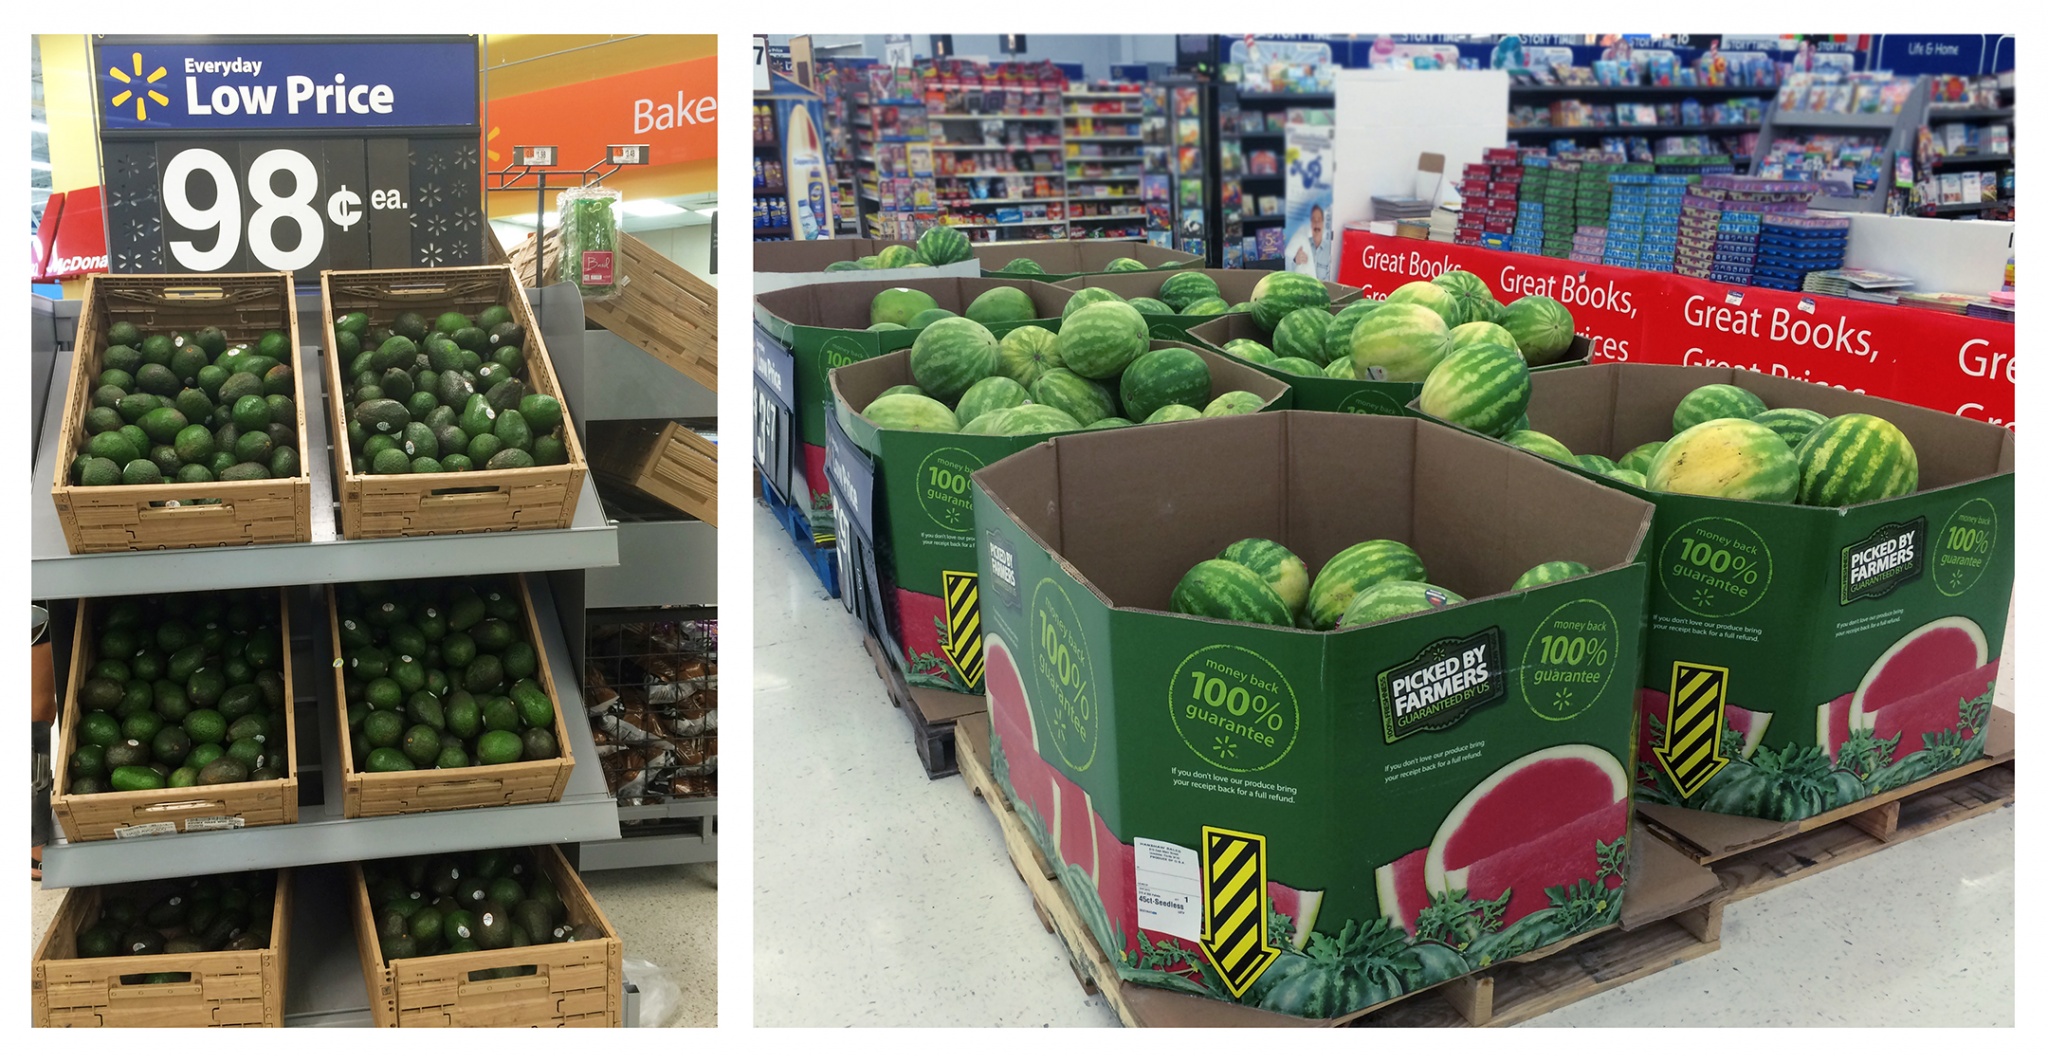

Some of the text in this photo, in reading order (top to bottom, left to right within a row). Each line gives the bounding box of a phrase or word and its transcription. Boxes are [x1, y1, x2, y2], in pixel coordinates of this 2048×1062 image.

[1908, 42, 1959, 55] Life & Home
[184, 57, 262, 77] Everyday
[186, 73, 395, 115] Low Price
[634, 90, 718, 135] Bake
[371, 188, 408, 210] ea.
[1362, 245, 1405, 275] Great
[1500, 265, 1638, 319] Great Books,
[1683, 294, 1762, 339] Great
[1770, 306, 1879, 364] Books,
[937, 458, 963, 471] money
[929, 466, 972, 499] 100
[1696, 528, 1758, 555] money back
[1851, 530, 1916, 569] PICKED BY
[1947, 525, 1990, 554] 100%
[1680, 538, 1758, 585] 100%
[1850, 545, 1915, 585] FARMERS
[1850, 560, 1914, 593] GUARANTEED BY US
[1940, 554, 1982, 568] guarantee
[1672, 564, 1748, 598] guarantee
[1045, 596, 1086, 667] money back
[1553, 619, 1608, 632] money back
[1669, 624, 1691, 634] receipt
[1692, 626, 1707, 636] back
[1689, 618, 1703, 626] love
[1716, 622, 1743, 632] produce
[1744, 625, 1763, 635] bring
[1039, 609, 1090, 721] 100%
[1540, 635, 1608, 666] 100%
[1206, 658, 1279, 694] money back
[1392, 656, 1461, 698] PICKED
[1462, 644, 1487, 669] BY
[1533, 668, 1601, 685] guarantee
[1039, 653, 1087, 743] guarantee
[1191, 671, 1283, 731] 100%
[1394, 662, 1489, 718] FARMERS
[1397, 681, 1490, 727] GUARANTEED BY US
[1185, 704, 1275, 748] guarantee
[1384, 774, 1399, 783] your
[1400, 767, 1421, 778] receipt
[1422, 763, 1437, 773] back
[1437, 760, 1446, 768] for
[1452, 756, 1461, 764] full
[1462, 750, 1482, 762] refund.
[1389, 763, 1401, 773] you
[1402, 758, 1418, 768] don't
[1419, 754, 1432, 764] love
[1433, 751, 1443, 759] our
[1444, 745, 1468, 757] produce
[1469, 740, 1485, 750] bring
[1177, 769, 1192, 777] you
[1193, 770, 1212, 780] don't
[1213, 774, 1229, 783] love
[1244, 779, 1276, 791] produce
[1276, 783, 1298, 795] bring
[1191, 781, 1217, 792] receipt
[1217, 784, 1236, 794] back
[1237, 787, 1248, 796] for
[1255, 790, 1267, 799] full
[1268, 793, 1296, 804] refund.
